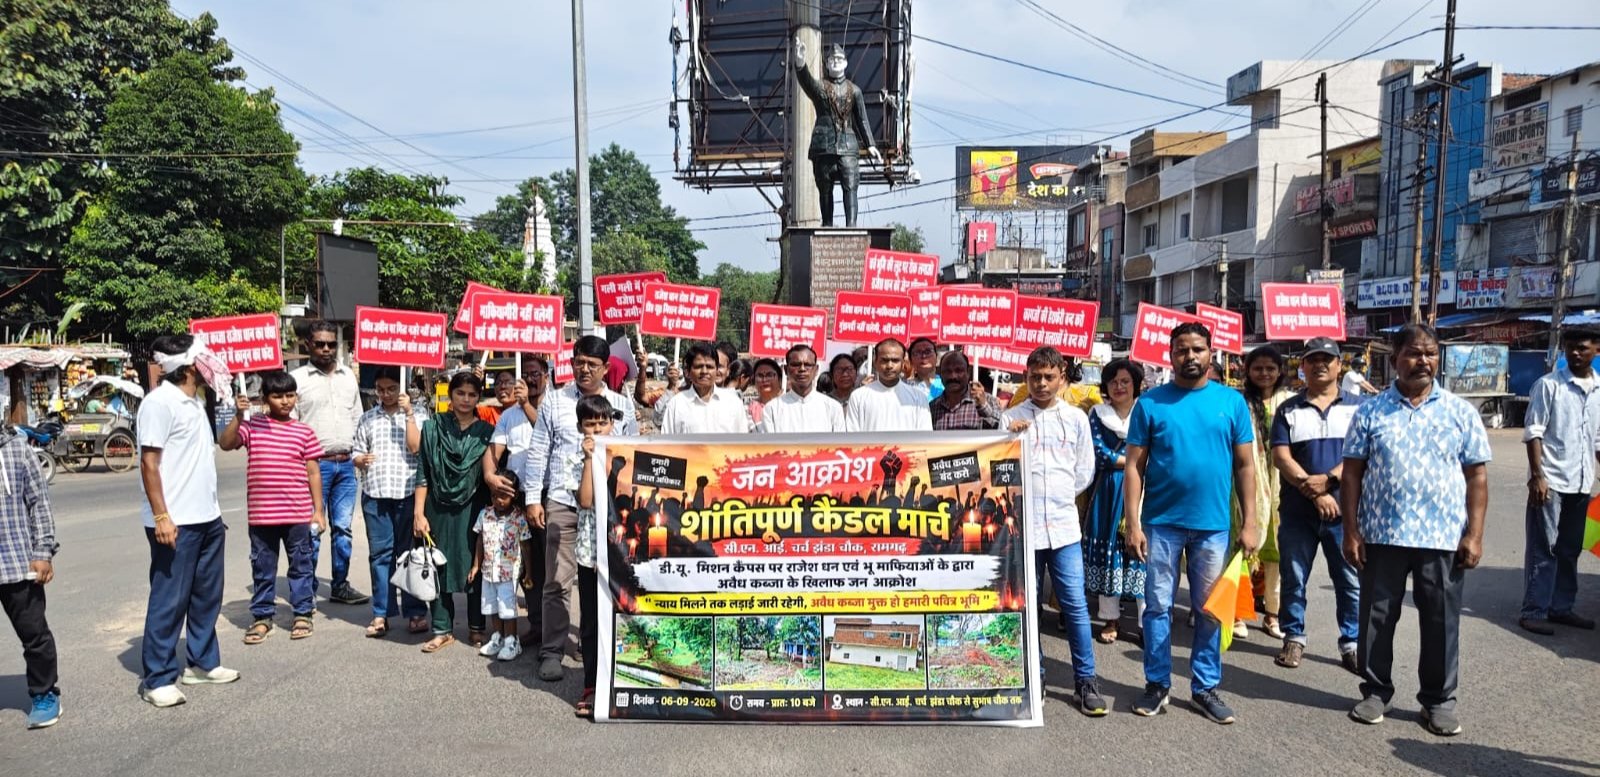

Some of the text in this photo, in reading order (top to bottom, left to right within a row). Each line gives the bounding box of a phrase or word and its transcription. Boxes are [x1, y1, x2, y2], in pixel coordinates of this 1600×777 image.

[1518, 120, 1545, 141] SPORTS
[1027, 181, 1050, 197] देश
[1052, 183, 1069, 196] का
[1338, 219, 1373, 236] SPORTS
[601, 281, 616, 294] गली
[618, 280, 632, 293] गली
[634, 279, 642, 291] में
[1376, 281, 1400, 295] BLUE
[616, 293, 635, 306] राजेश
[519, 302, 533, 321] नहीं
[534, 304, 554, 323] चलेगी
[605, 307, 623, 319] पवित्र
[755, 312, 767, 325] एक
[498, 323, 519, 342] जमीन
[520, 324, 534, 343] नहीं
[651, 457, 671, 467] हमारी
[932, 457, 975, 471] अवैध कब्जा
[996, 462, 1014, 472] न्याय
[652, 467, 667, 476] भूमि
[731, 450, 876, 491] जन आक्रोश
[939, 466, 970, 482] बंद करो
[656, 477, 681, 487] अधिकार
[1001, 473, 1010, 483] दो
[680, 496, 951, 544] शांतिपूर्ण कैंडल मार्च
[724, 541, 907, 555] सी.एन. आई. चर्च झंडा चौक, रामगढ़
[659, 561, 691, 577] डी.यू.
[697, 560, 730, 574] मिशन
[768, 563, 783, 573] पर
[786, 559, 819, 573] राजेश
[822, 562, 839, 573] धन
[842, 559, 859, 572] एवं
[863, 561, 875, 575] भू
[876, 558, 934, 572] माफियाओं
[937, 558, 949, 571] के
[952, 560, 975, 573] द्वारा
[717, 573, 917, 589] अवैध कब्जा के खिलाफ जन आक्रोश
[654, 594, 980, 611] न्याय मिलने तक लड़ाई जारी रहेगी, अवैध कब्जा मुक्त हो हमारी पवित्र भूमि
[633, 694, 655, 705] दिनांक
[661, 695, 689, 707] 06-09
[747, 698, 764, 708] समय
[790, 697, 800, 708] 10
[802, 696, 816, 708] बजे
[845, 697, 864, 708] स्थान
[915, 695, 927, 707] चर्च
[930, 695, 945, 707] झंडा
[946, 694, 962, 707] चौक
[963, 694, 971, 706] से
[972, 695, 991, 708] सुभाष
[993, 692, 1009, 705] चौक
[1010, 695, 1023, 705] तक
